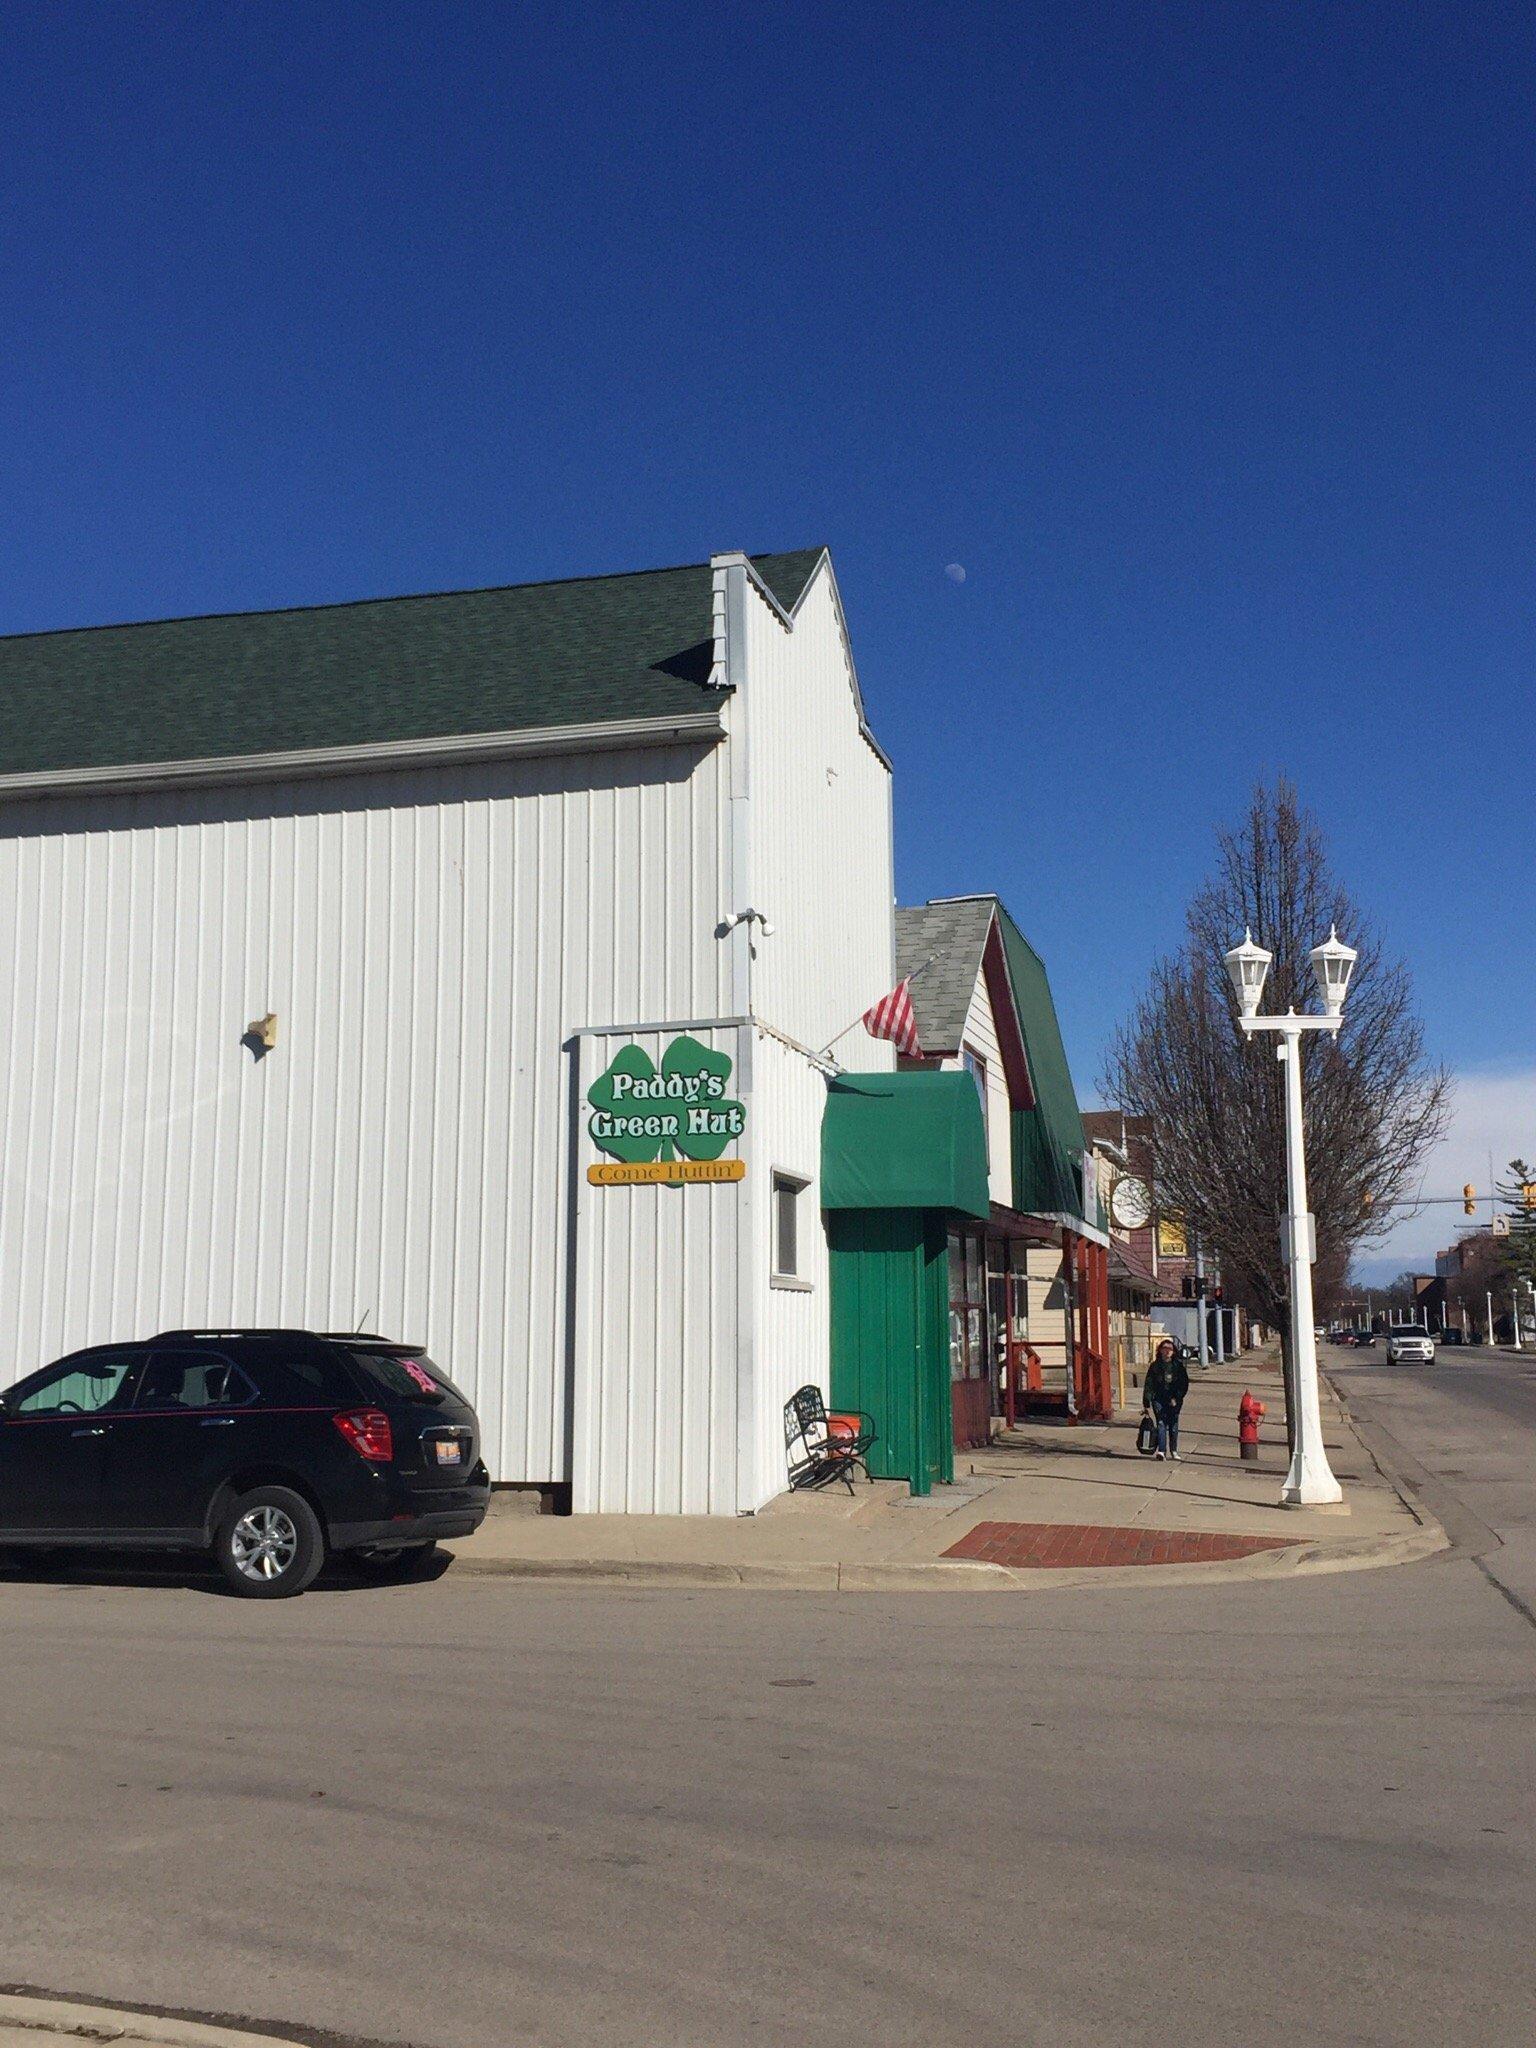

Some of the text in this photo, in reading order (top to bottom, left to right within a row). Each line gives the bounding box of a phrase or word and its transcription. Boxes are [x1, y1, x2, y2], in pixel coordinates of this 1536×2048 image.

[611, 1069, 724, 1103] Paddy's
[590, 1107, 743, 1138] Green Hut
[598, 1163, 735, 1181] Come Huttin'
